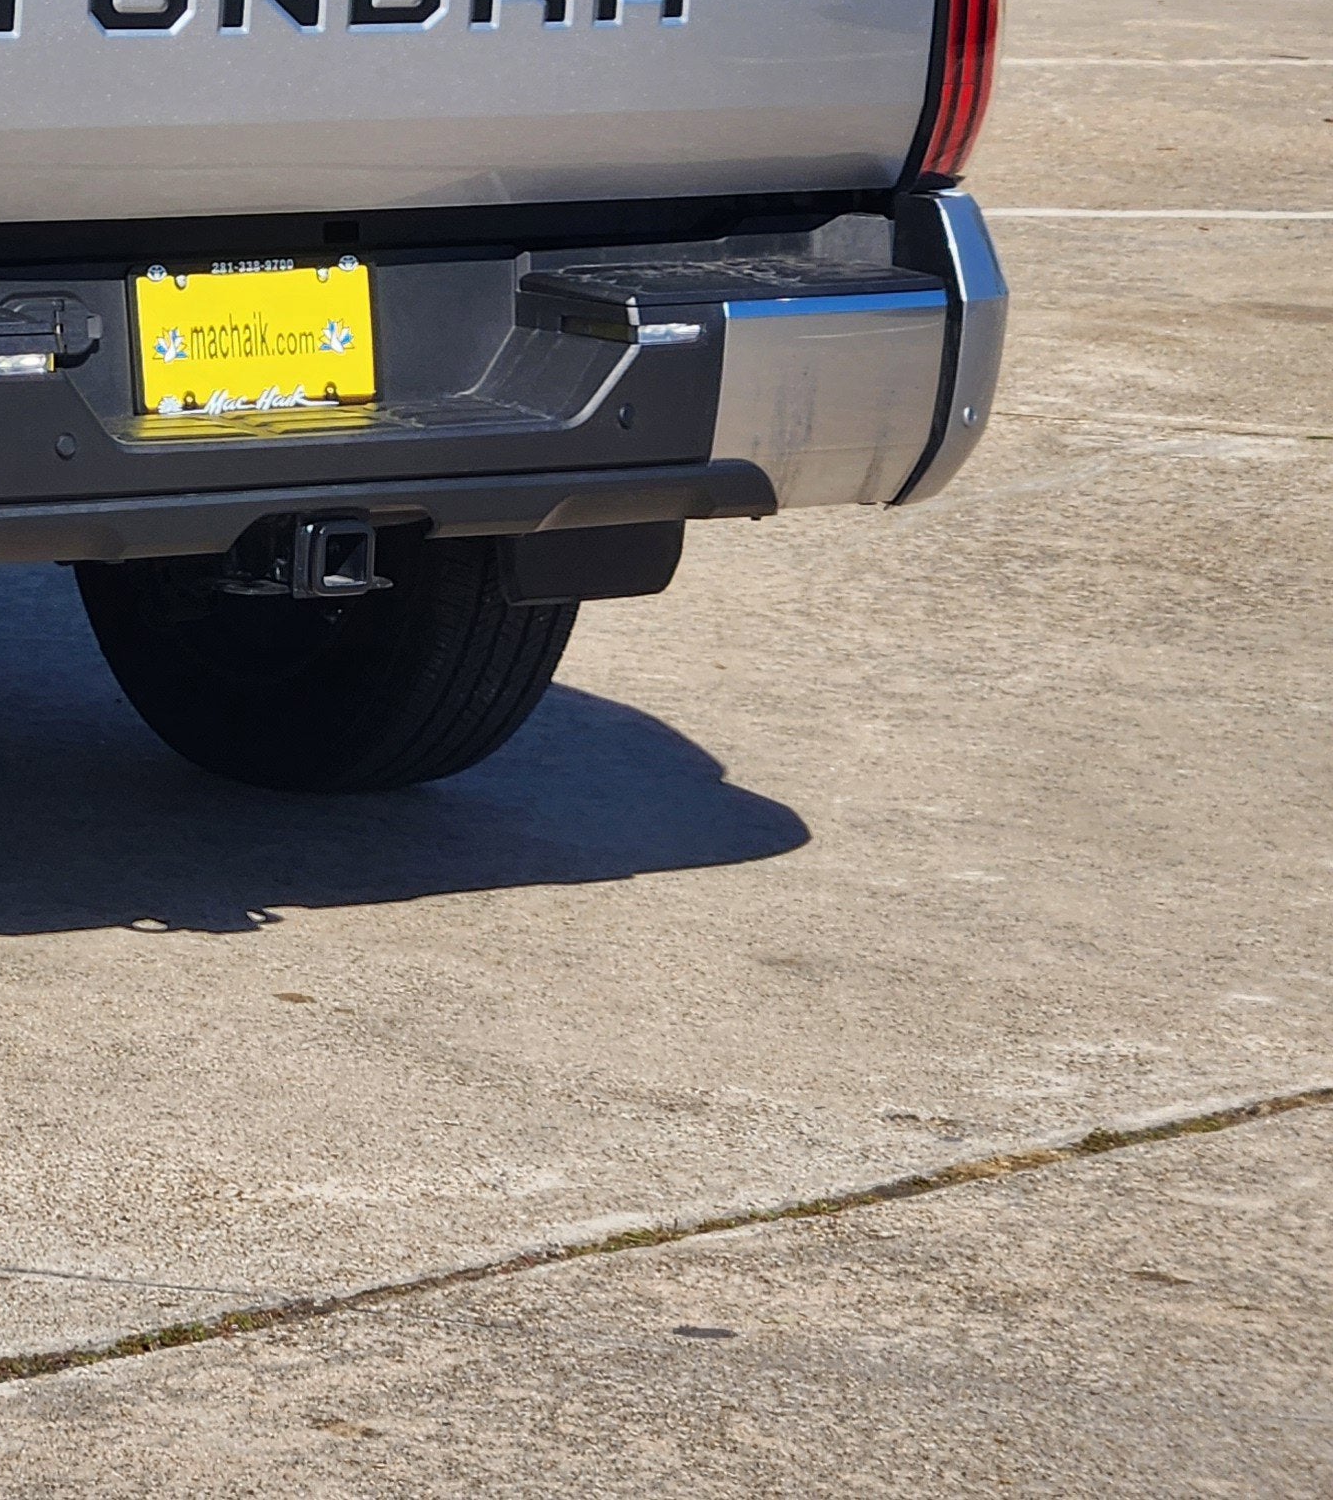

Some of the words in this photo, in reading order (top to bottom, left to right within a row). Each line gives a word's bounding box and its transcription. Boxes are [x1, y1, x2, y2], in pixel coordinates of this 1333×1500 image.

[189, 311, 316, 361] machaik.com
[202, 388, 254, 415] Mac
[253, 383, 321, 411] Haik
